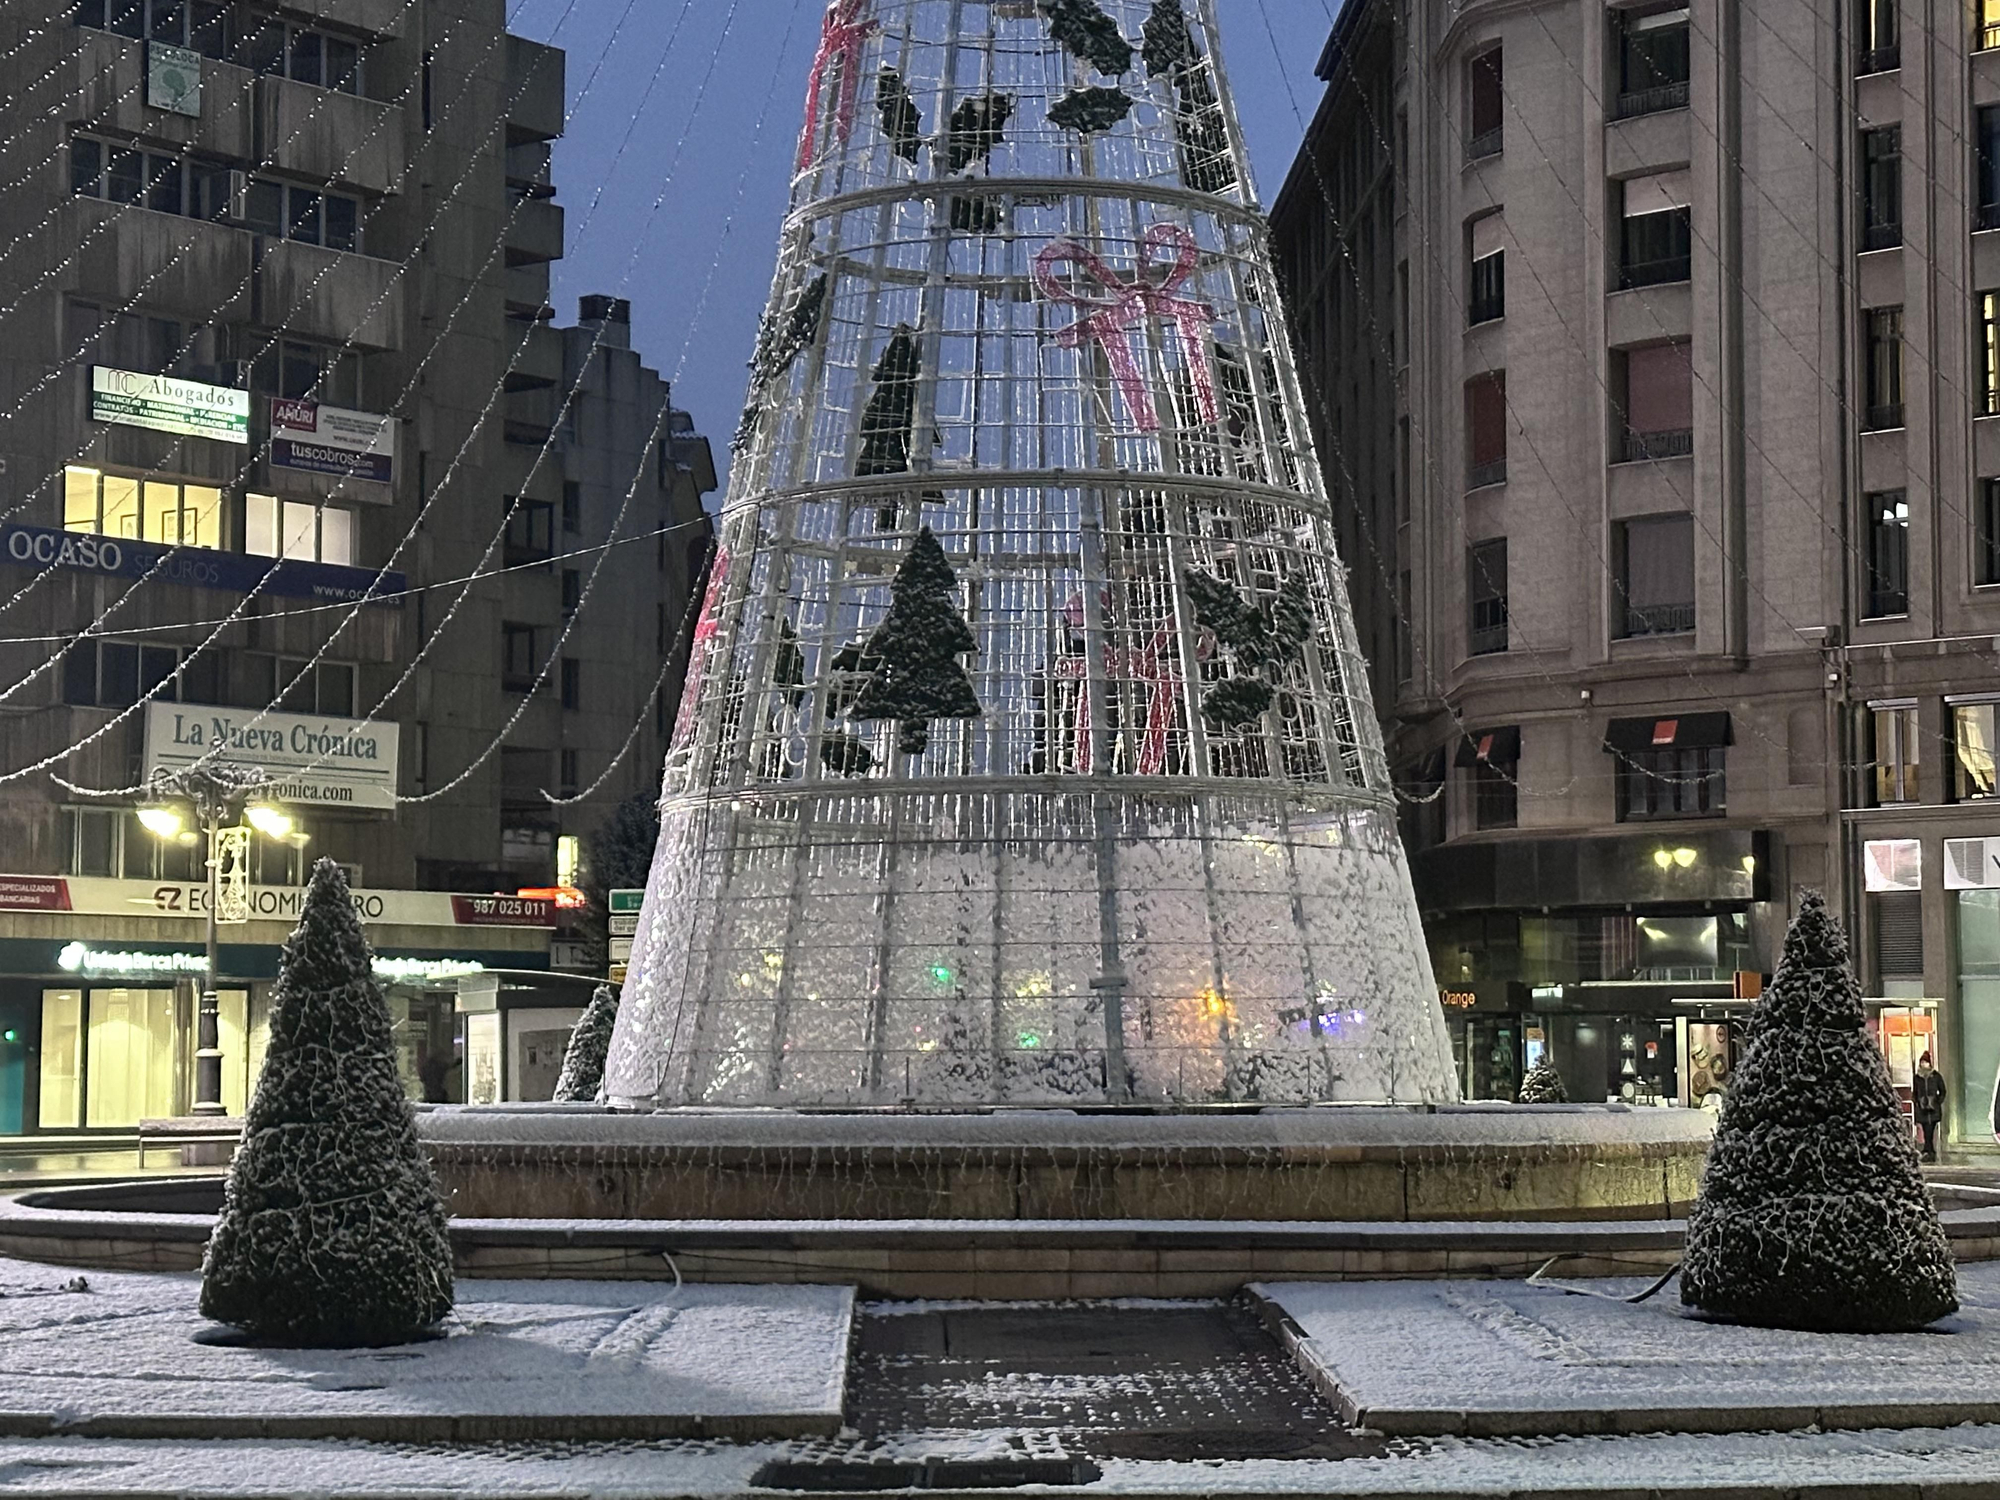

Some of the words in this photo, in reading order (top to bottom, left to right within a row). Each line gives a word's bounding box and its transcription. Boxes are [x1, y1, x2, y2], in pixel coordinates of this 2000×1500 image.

[149, 378, 234, 406] Abogados
[93, 401, 134, 414] CONTRATOS
[8, 531, 122, 570] OCASO
[134, 554, 219, 583] SEGUROS
[173, 714, 203, 745] La
[211, 718, 284, 752] Nueva
[290, 723, 377, 759] Crónica
[473, 900, 496, 914] 987
[499, 901, 521, 915] 025
[524, 901, 546, 916] 011
[1442, 989, 1476, 1008] Orange
